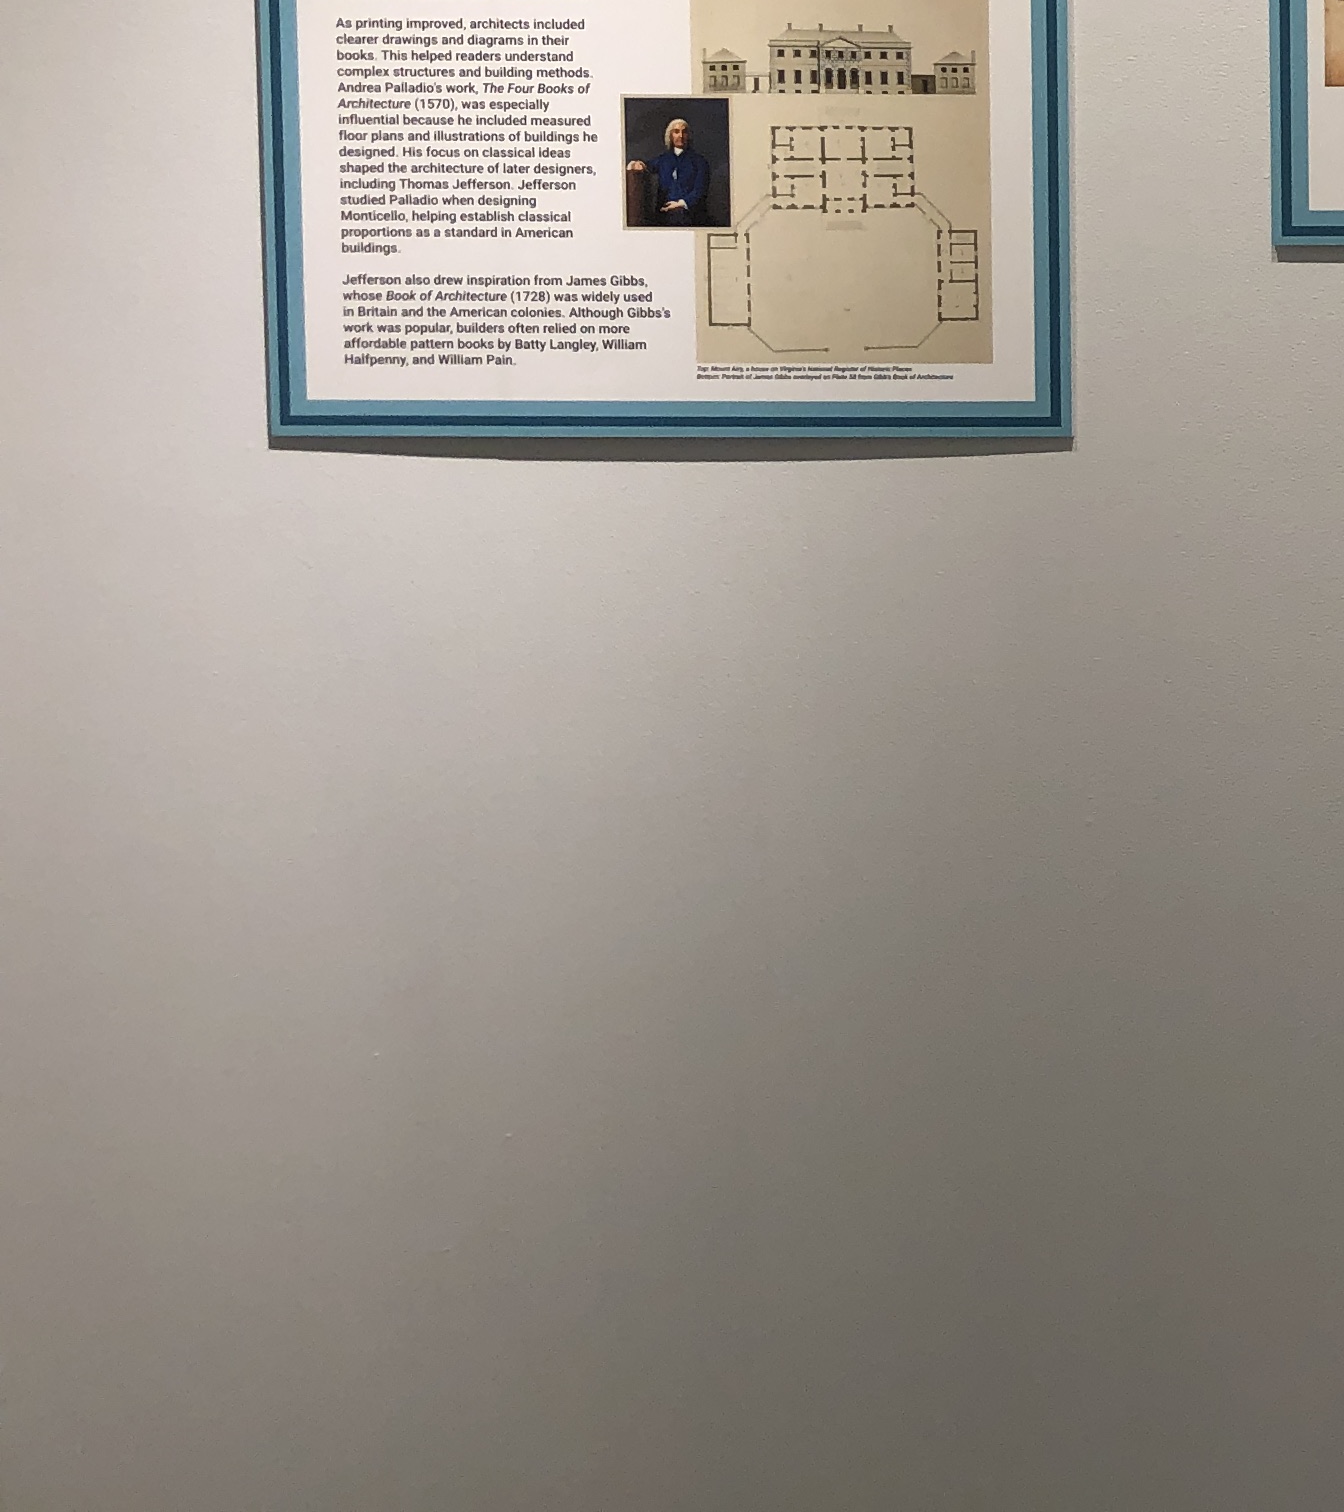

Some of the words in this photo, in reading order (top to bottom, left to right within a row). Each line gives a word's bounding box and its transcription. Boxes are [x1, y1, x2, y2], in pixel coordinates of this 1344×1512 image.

[335, 17, 352, 28] As
[355, 17, 403, 31] printing
[406, 17, 466, 31] improved,
[469, 17, 530, 29] architects
[533, 18, 585, 30] included
[336, 65, 389, 79] complex
[392, 66, 455, 77] structures
[458, 65, 481, 78] and
[484, 66, 533, 81] building
[536, 66, 593, 78] methods.
[337, 81, 381, 93] Andrea
[384, 81, 442, 93] Palladio's
[445, 81, 478, 95] work,
[482, 82, 504, 94] The
[507, 82, 535, 94] Four
[537, 82, 574, 94] Books
[577, 82, 591, 94] of
[339, 177, 396, 192] including
[398, 177, 449, 190] Thomas
[452, 177, 514, 190] Jefferson.
[517, 178, 576, 190] Jefferson
[342, 273, 402, 285] Jefferson
[404, 273, 430, 285] also
[433, 274, 463, 286] drew
[466, 274, 531, 288] inspiration
[533, 274, 563, 286] from
[565, 275, 607, 286] James
[609, 274, 648, 288] Gibbs,
